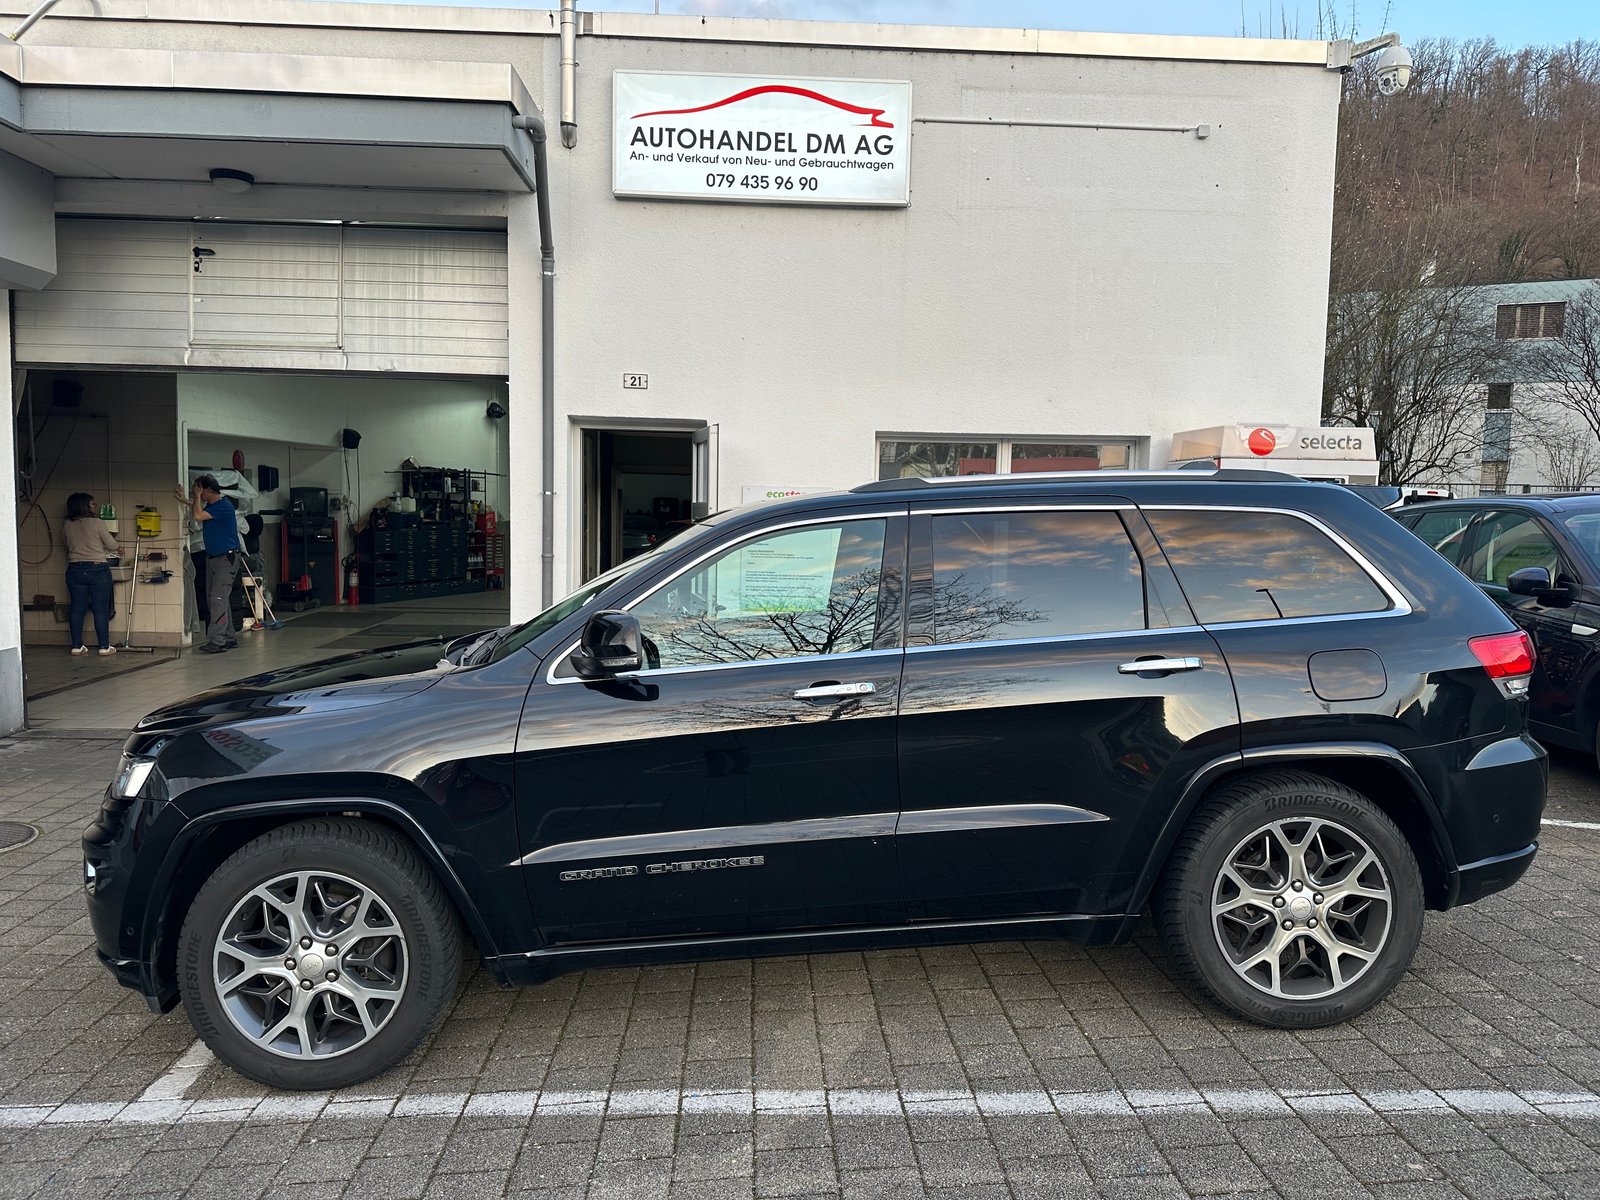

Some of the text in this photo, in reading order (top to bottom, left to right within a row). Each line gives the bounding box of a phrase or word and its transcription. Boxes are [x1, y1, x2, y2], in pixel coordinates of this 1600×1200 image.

[630, 126, 894, 156] AUTOHANDEL DM AG
[629, 151, 894, 172] An- und Verkauf von Neu- und Gebrauchtwagen
[706, 173, 818, 191] 079 435 96 90
[630, 375, 642, 387] 21
[1300, 434, 1362, 450] selecta
[1264, 794, 1368, 820] BRIDGESTONE
[559, 855, 765, 881] GRAND CHEROKEE
[185, 930, 220, 1039] BRIDGESTONE
